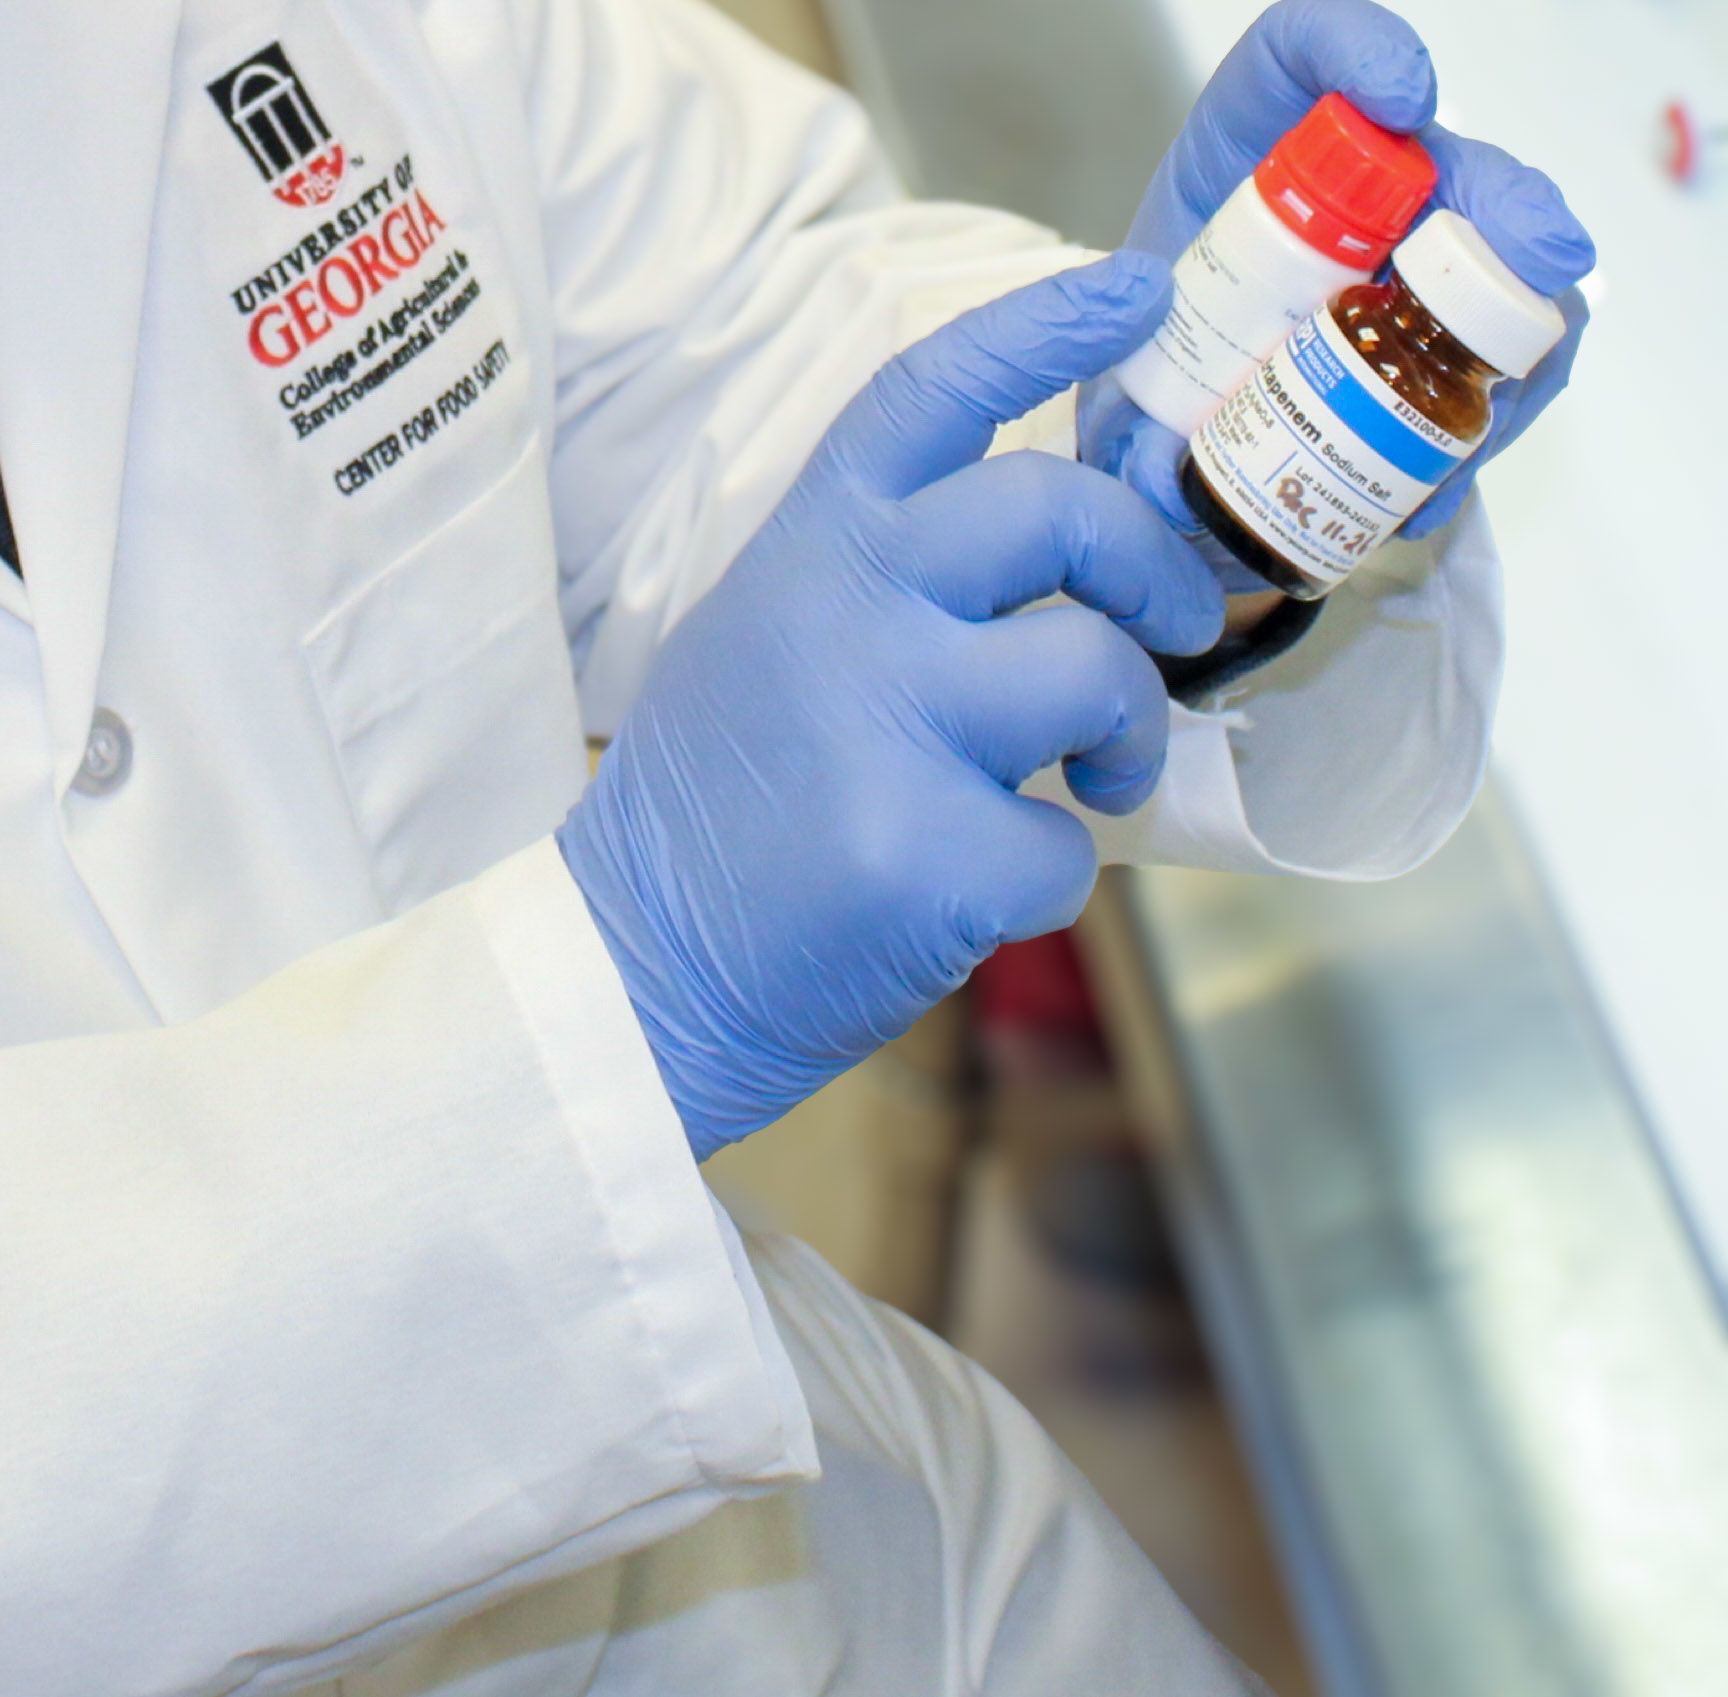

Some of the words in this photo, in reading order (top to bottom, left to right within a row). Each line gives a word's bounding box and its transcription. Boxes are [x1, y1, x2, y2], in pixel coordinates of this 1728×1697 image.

[230, 177, 394, 313] UNIVERSITY
[393, 154, 415, 193] OF
[248, 188, 447, 367] GEORGIA
[278, 347, 357, 410] College
[359, 327, 376, 357] of
[290, 320, 435, 439] Environmental
[1302, 347, 1338, 389] PRODUCTS
[1312, 338, 1346, 379] RESEARCH
[334, 426, 404, 496] CENTER
[402, 404, 438, 452] FOR
[437, 376, 478, 425] FOOD
[474, 339, 509, 391] SAFETY
[1295, 466, 1314, 485] Lot
[1321, 441, 1370, 486] Sodium
[1367, 480, 1391, 501] Salt
